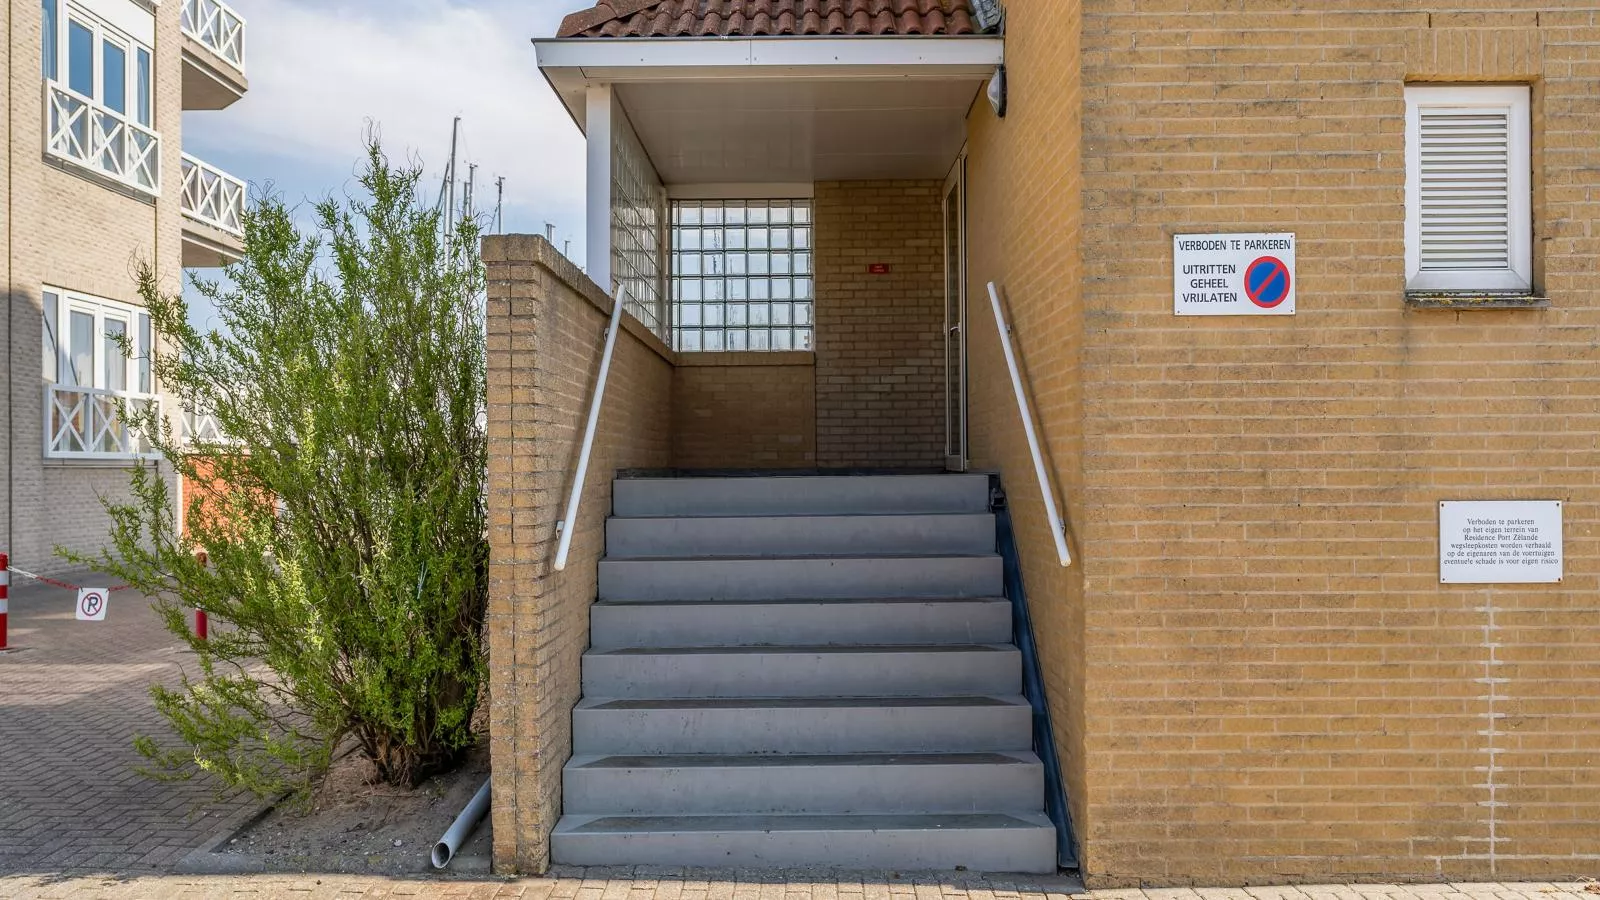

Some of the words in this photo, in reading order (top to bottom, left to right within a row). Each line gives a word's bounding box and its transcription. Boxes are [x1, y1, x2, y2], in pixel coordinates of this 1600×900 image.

[1178, 240, 1227, 251] VERBODEN
[1230, 239, 1241, 250] TE
[1244, 239, 1291, 250] PARKEREN
[1182, 264, 1236, 275] UITRITTEN
[1190, 278, 1229, 289] GEHEEL
[1182, 292, 1237, 303] VRIJLATEN
[1507, 518, 1534, 526] parkeren
[1521, 550, 1555, 558] voertuigen
[1521, 558, 1539, 566] eigen
